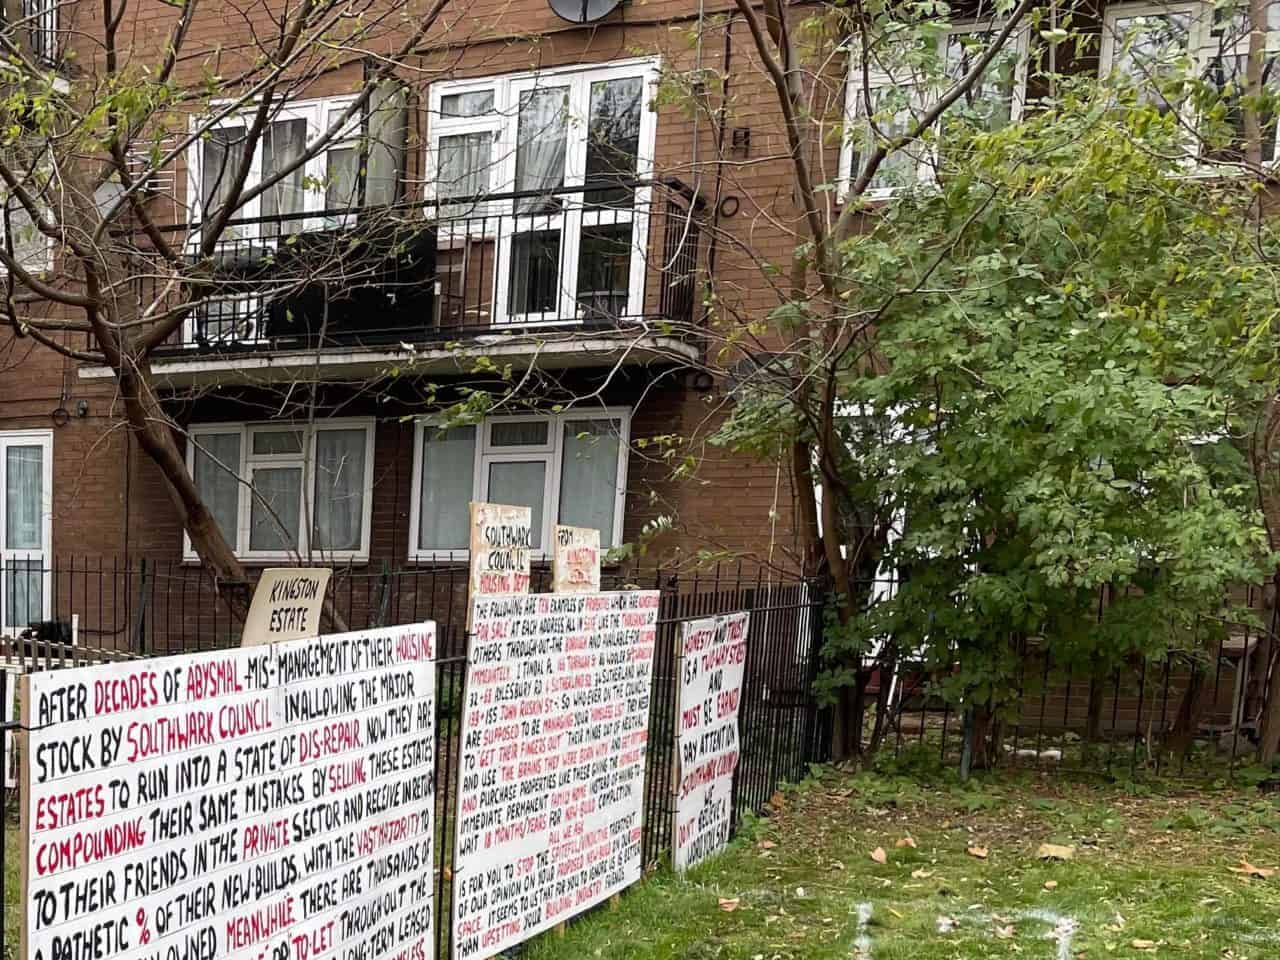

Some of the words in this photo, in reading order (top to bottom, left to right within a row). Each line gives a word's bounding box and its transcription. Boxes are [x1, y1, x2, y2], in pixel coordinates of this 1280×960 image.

[485, 525, 531, 549] SOUTHWARK
[488, 550, 525, 570] COUNCIL
[269, 577, 319, 603] KINGSTON
[269, 606, 308, 632] ESTATE
[473, 643, 502, 665] OTHERS
[37, 683, 87, 728] AFTER
[94, 672, 158, 715] DECADES
[163, 667, 182, 703] OF
[186, 659, 243, 701] ABYSMAL
[351, 639, 362, 672] OF
[362, 637, 394, 668] THEIR
[396, 632, 432, 662] HOUSING
[495, 681, 531, 701] AYLESBURY
[36, 734, 95, 784] STOCK
[100, 725, 123, 768] BY
[127, 711, 215, 763] SOUTHWARK
[219, 698, 272, 739] COUNCIL
[285, 691, 300, 724] IN
[300, 681, 357, 721] ALLOWING
[359, 676, 378, 708] THE
[380, 671, 415, 701] MAJOR
[466, 730, 482, 750] ARE
[483, 724, 519, 746] SUPPOSED
[521, 721, 529, 736] TO
[531, 719, 540, 736] BE
[35, 784, 105, 830] ESTATES
[108, 779, 130, 810] TO
[137, 764, 168, 805] RUN
[175, 755, 210, 793] INTO
[216, 749, 227, 784] A
[234, 740, 276, 782] STATE
[280, 734, 296, 766] OF
[367, 712, 387, 745] NOW
[388, 704, 413, 737] THEY
[417, 699, 432, 729] ARE
[463, 773, 478, 792] AND
[482, 769, 497, 787] USE
[36, 816, 146, 876] COMPOUNDING
[149, 801, 194, 843] THEIR
[199, 788, 238, 831] SAME
[245, 772, 305, 813] MISTAKES
[312, 766, 327, 799] BY
[329, 757, 366, 793] SELLING
[368, 747, 399, 780] THESE
[402, 735, 432, 770] ESTATES
[480, 784, 517, 808] PURCHASE
[461, 808, 502, 834] IMMEDIATE
[506, 794, 549, 821] PERMANENT
[33, 888, 57, 930] TO
[59, 870, 117, 921] THEIR
[123, 848, 188, 902] FRIENDS
[193, 840, 207, 877] IN
[209, 828, 238, 869] THE
[243, 818, 290, 861] PRIVATE
[292, 800, 341, 843] SECTOR
[343, 792, 363, 824] AND
[366, 781, 401, 817] RECEIVE
[402, 779, 411, 805] IN
[469, 873, 483, 894] FOR
[487, 869, 501, 886] YOU
[504, 864, 514, 879] TO
[518, 856, 533, 876] STOP
[536, 849, 549, 869] THE
[136, 907, 151, 945] %
[155, 900, 173, 936] OF
[175, 882, 216, 927] THEIR
[304, 841, 332, 873] WITH
[335, 832, 355, 862] THE
[356, 825, 378, 856] VAST
[421, 808, 429, 832] TO
[409, 872, 427, 904] THE
[226, 896, 296, 953] MEANWHILE
[299, 878, 338, 919] THERE
[342, 865, 362, 901] ARE
[367, 842, 419, 888] THOUSANDS
[421, 837, 431, 865] OF
[458, 899, 468, 920] OF
[470, 892, 487, 913] OUR
[491, 880, 521, 905] OPINION
[524, 875, 535, 892] ON
[398, 904, 430, 942] LEASED
[456, 936, 479, 960] THAN
